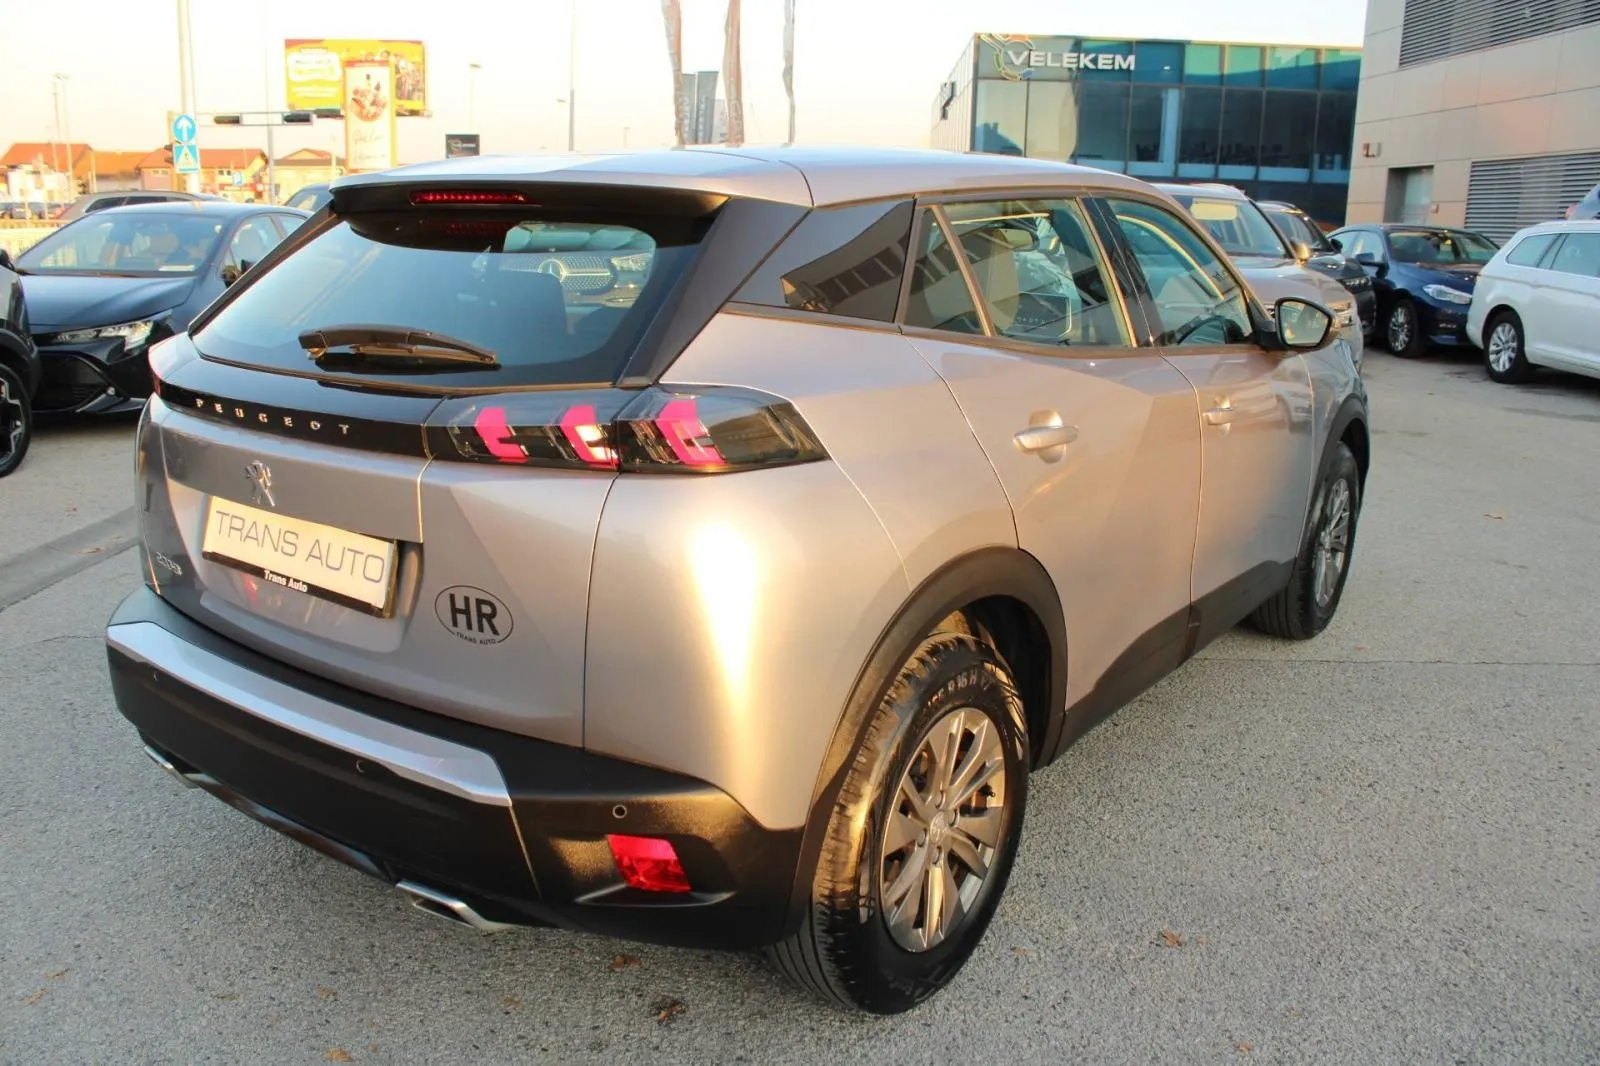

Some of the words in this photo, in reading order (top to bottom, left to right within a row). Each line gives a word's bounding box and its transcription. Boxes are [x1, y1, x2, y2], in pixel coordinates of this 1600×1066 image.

[1007, 50, 1135, 71] VELEKEM
[196, 398, 349, 434] PEUGEOT
[216, 510, 299, 557] TRANS
[305, 538, 385, 583] AUTO
[264, 569, 286, 587] Trans
[288, 577, 308, 593] Auto
[449, 593, 500, 636] HR
